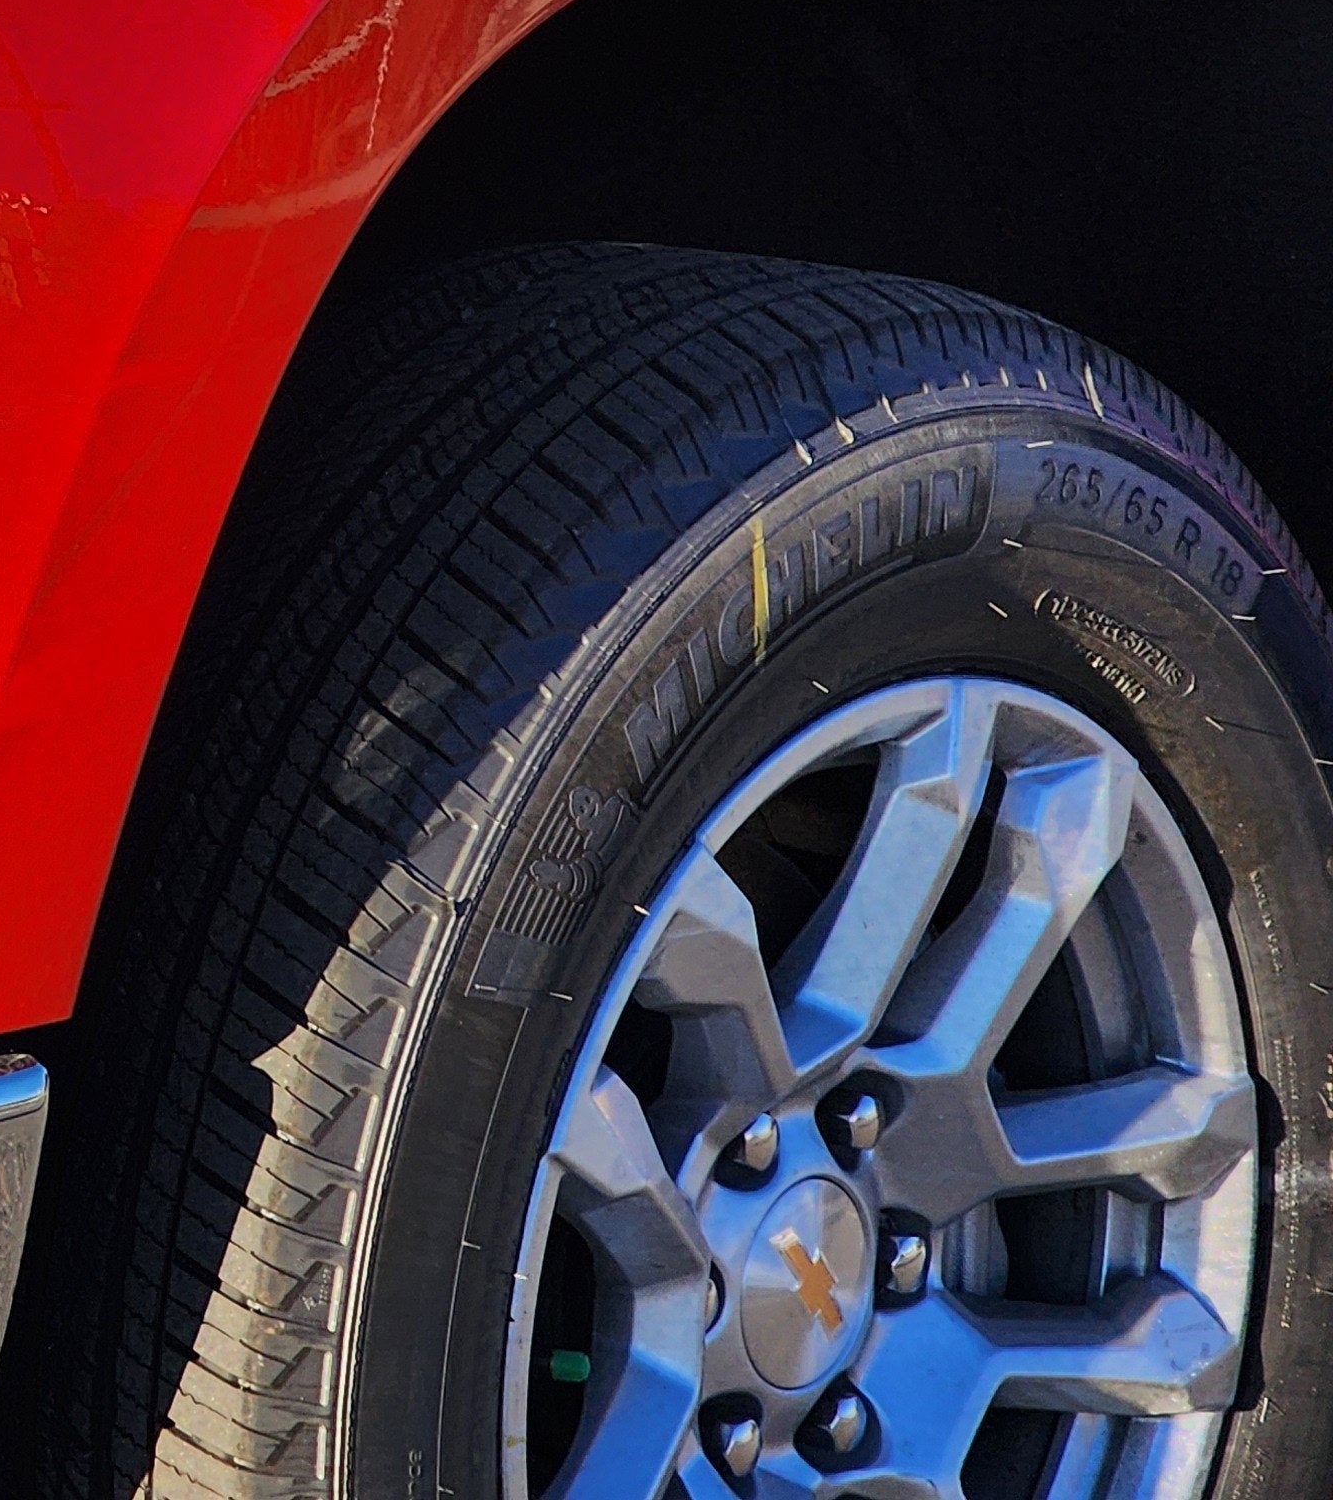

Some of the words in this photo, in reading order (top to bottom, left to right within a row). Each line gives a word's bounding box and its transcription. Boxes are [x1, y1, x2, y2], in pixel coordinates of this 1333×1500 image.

[623, 466, 978, 784] MICHELIN
[1035, 456, 1167, 536] 265/65
[1175, 515, 1201, 560] R
[1211, 546, 1244, 597] 18
